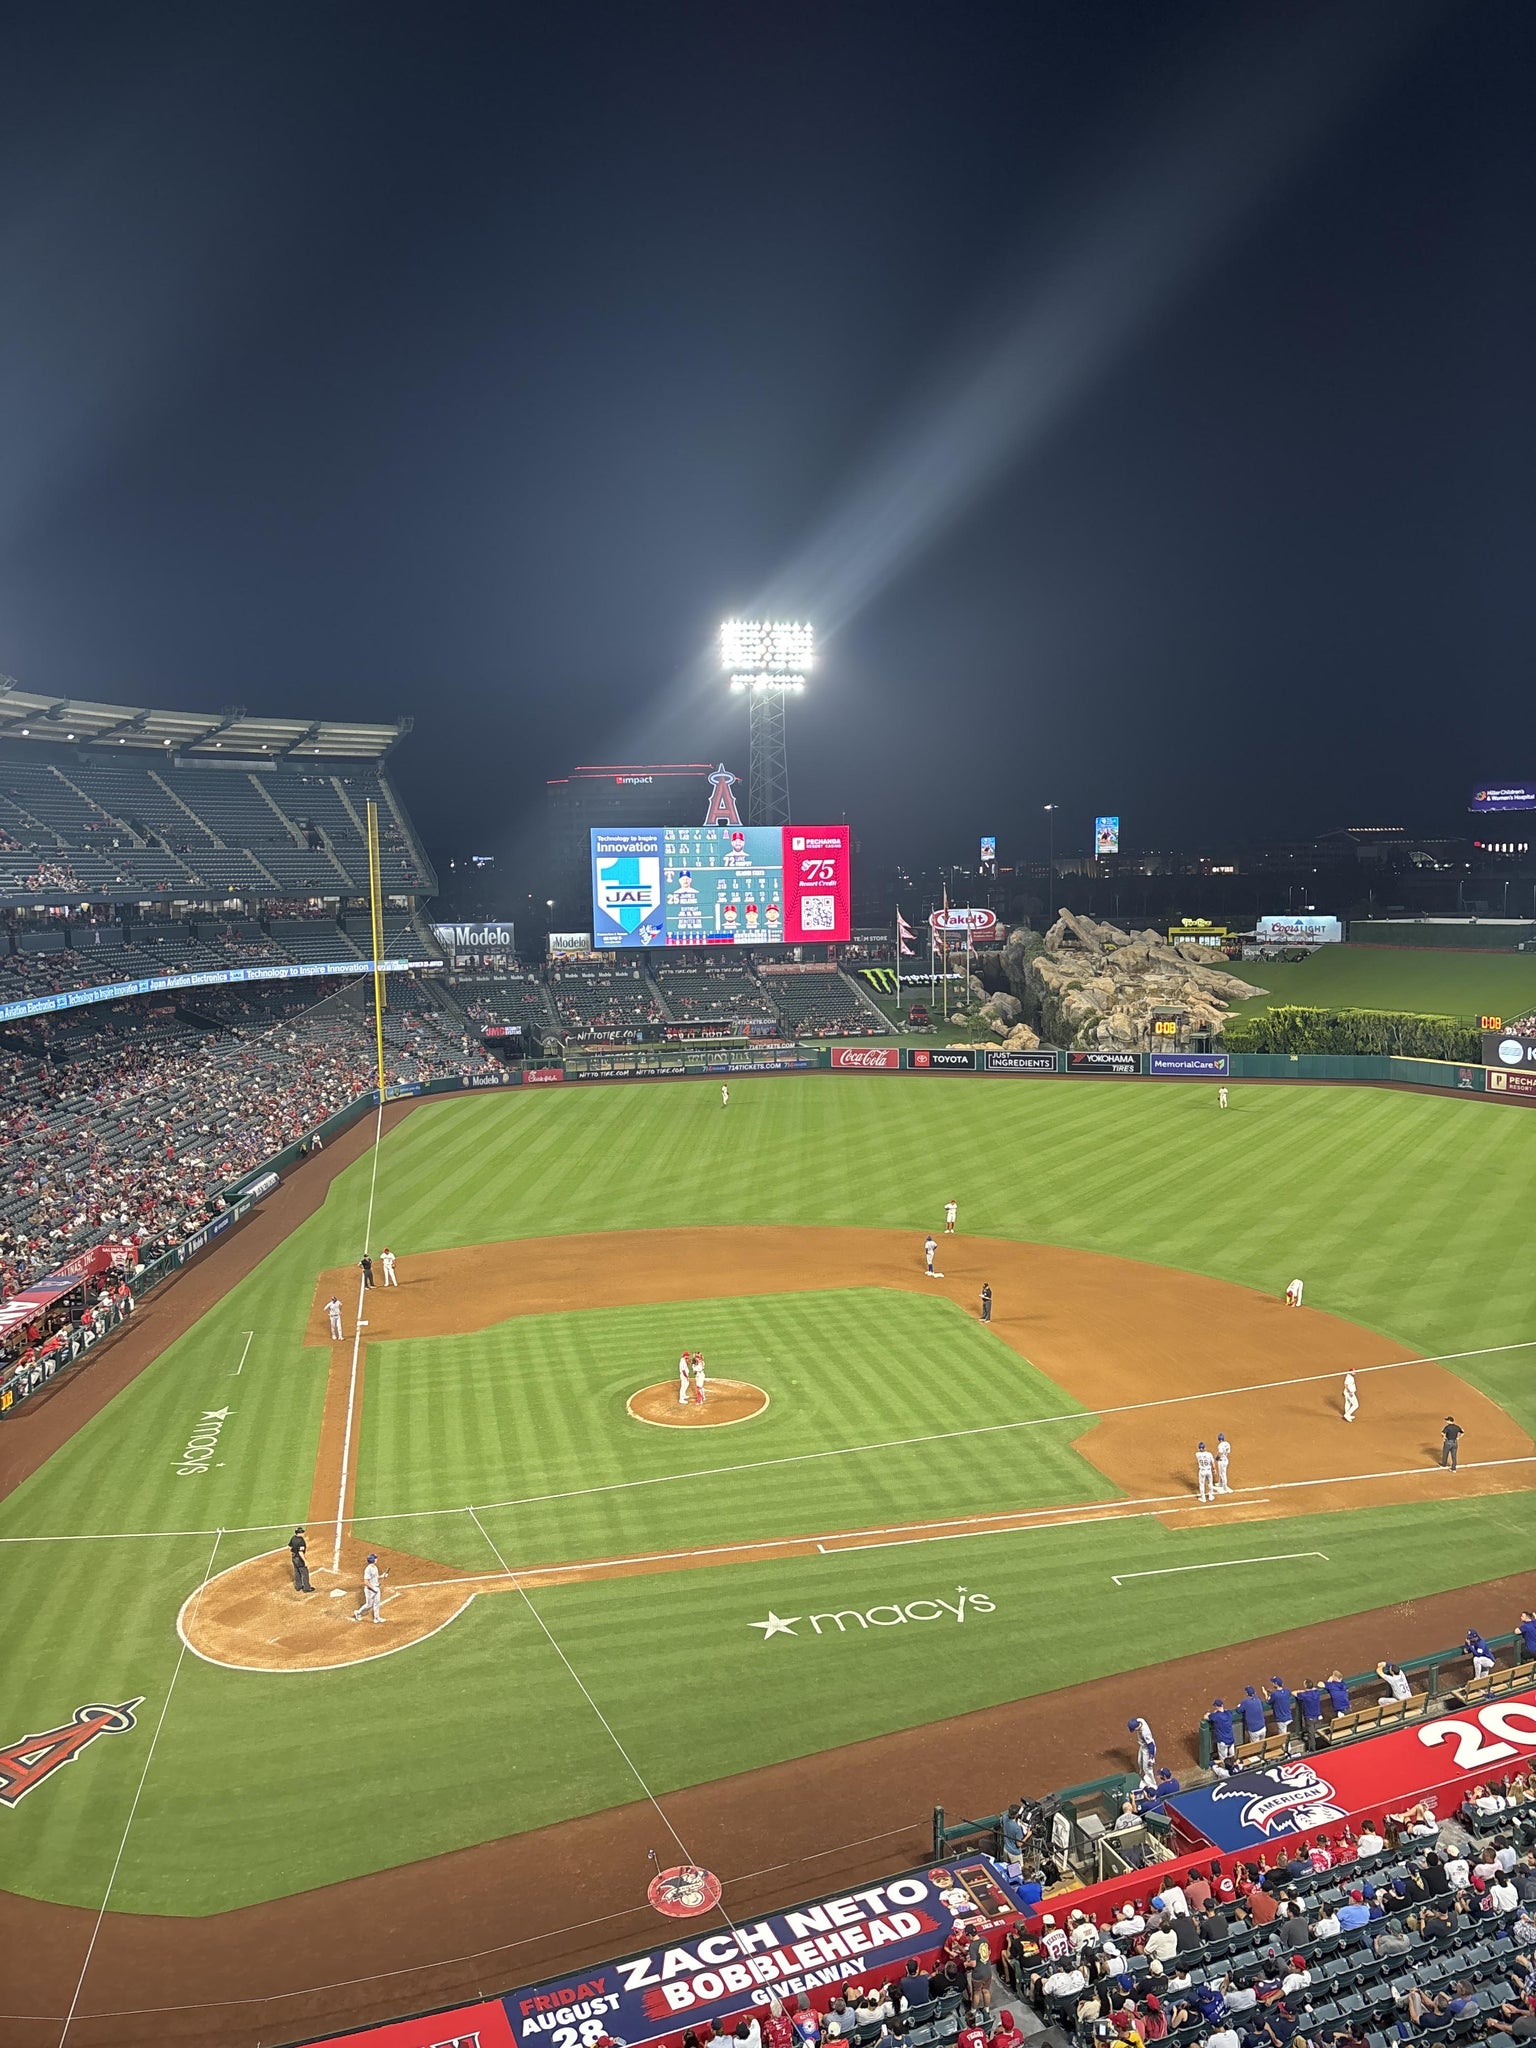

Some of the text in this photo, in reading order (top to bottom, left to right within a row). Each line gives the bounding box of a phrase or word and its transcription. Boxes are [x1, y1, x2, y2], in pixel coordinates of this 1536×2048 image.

[623, 776, 653, 785] impact
[597, 842, 658, 852] Innovation
[723, 856, 735, 866] 72
[801, 860, 836, 880] $75
[606, 891, 652, 902] JAE
[667, 894, 680, 904] 25
[1272, 922, 1300, 933] Coors
[456, 927, 510, 945] Modelo
[555, 936, 586, 948] Modelo
[247, 968, 288, 978] Technology
[290, 966, 298, 974] to
[300, 964, 325, 974] Inspire
[328, 964, 368, 972] Innovation
[167, 976, 190, 988] Aviation
[192, 974, 227, 984] Electronics
[5, 1004, 27, 1017] Aviation
[28, 1000, 56, 1014] Electronics
[1155, 1021, 1175, 1034] 0:08
[1482, 1016, 1501, 1029] 0:08
[486, 1026, 505, 1036] JMG
[577, 1030, 637, 1040] NITTOTIRE.CO
[840, 1049, 888, 1066] Coca-Cola
[933, 1055, 968, 1063] TOYOTA
[992, 1058, 1050, 1067] INGREDIENTS
[1086, 1054, 1135, 1063] YOKOHAMA
[1155, 1060, 1213, 1069] MemorialCare
[472, 1075, 499, 1086] Modelo
[1509, 1077, 1536, 1086] PECHA
[61, 1260, 83, 1276] ALINAS,
[83, 1252, 96, 1266] INC.
[1258, 1788, 1322, 1814] AMERICAN
[617, 1880, 928, 1992] ZACH NETO
[1083, 1936, 1096, 1949] 27
[1052, 1941, 1067, 1958] 22
[661, 1912, 921, 2012] BOBBLEHEAD
[750, 1956, 867, 2006] GIVEAWAY
[519, 1978, 606, 2016] FRIDAY
[522, 1993, 620, 2038] AUGUST
[552, 2018, 606, 2048] 28
